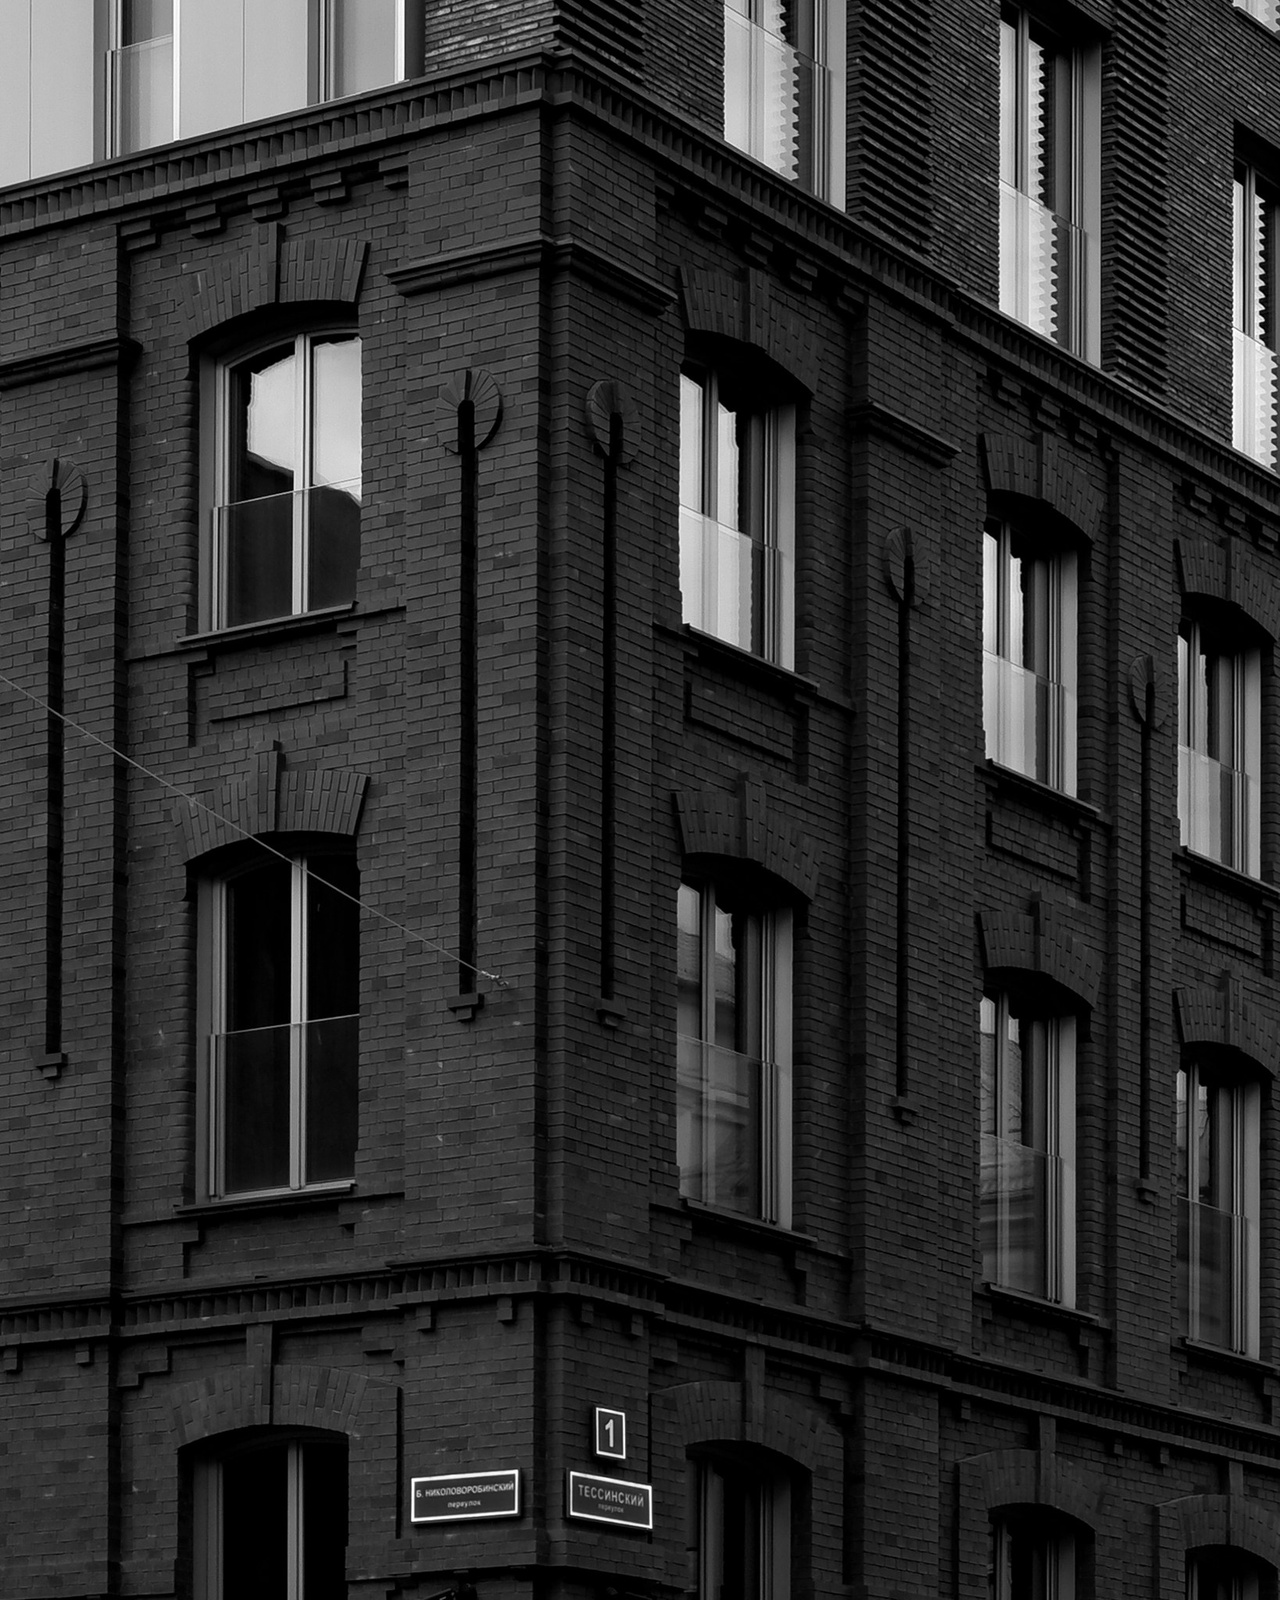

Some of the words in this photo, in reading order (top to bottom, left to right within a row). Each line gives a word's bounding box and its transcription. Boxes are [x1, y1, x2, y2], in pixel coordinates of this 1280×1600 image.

[605, 1419, 614, 1448] 1
[415, 1489, 424, 1498] Б.
[425, 1481, 514, 1497] НИКОЛОВОРОБИНСКИЙ
[578, 1484, 644, 1507] ТЕССИНСКИЙ
[447, 1500, 481, 1509] переулок
